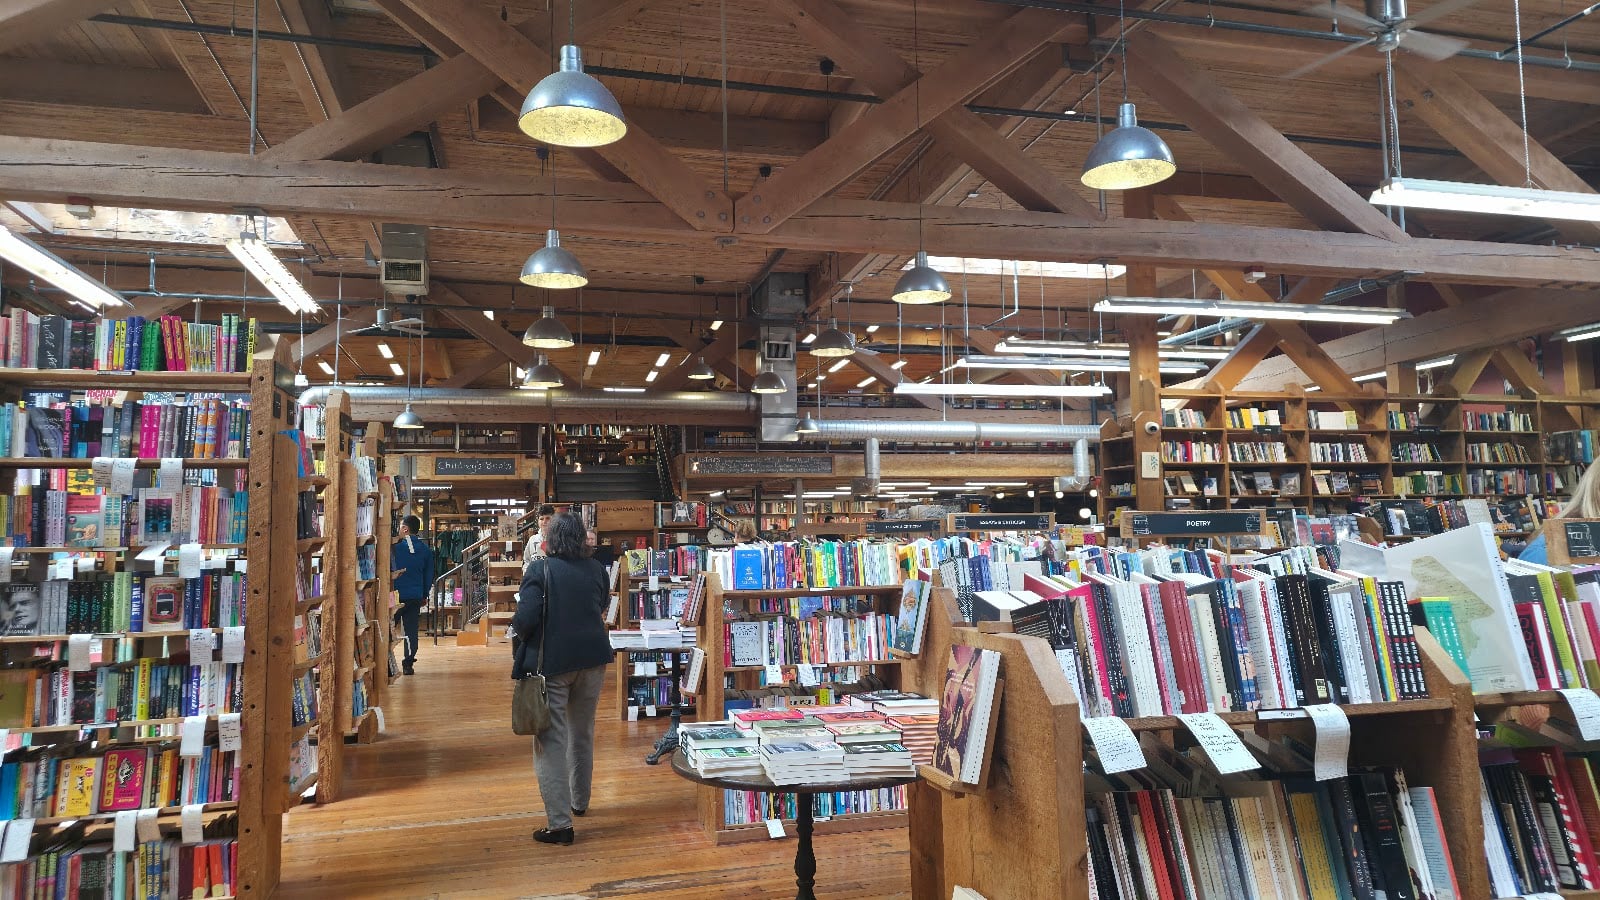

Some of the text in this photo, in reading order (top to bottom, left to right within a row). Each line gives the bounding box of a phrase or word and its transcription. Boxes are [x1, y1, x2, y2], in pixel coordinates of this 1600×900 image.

[58, 763, 71, 812] BUTTER
[104, 756, 117, 804] HOOKED
[1355, 861, 1365, 888] POEMS
